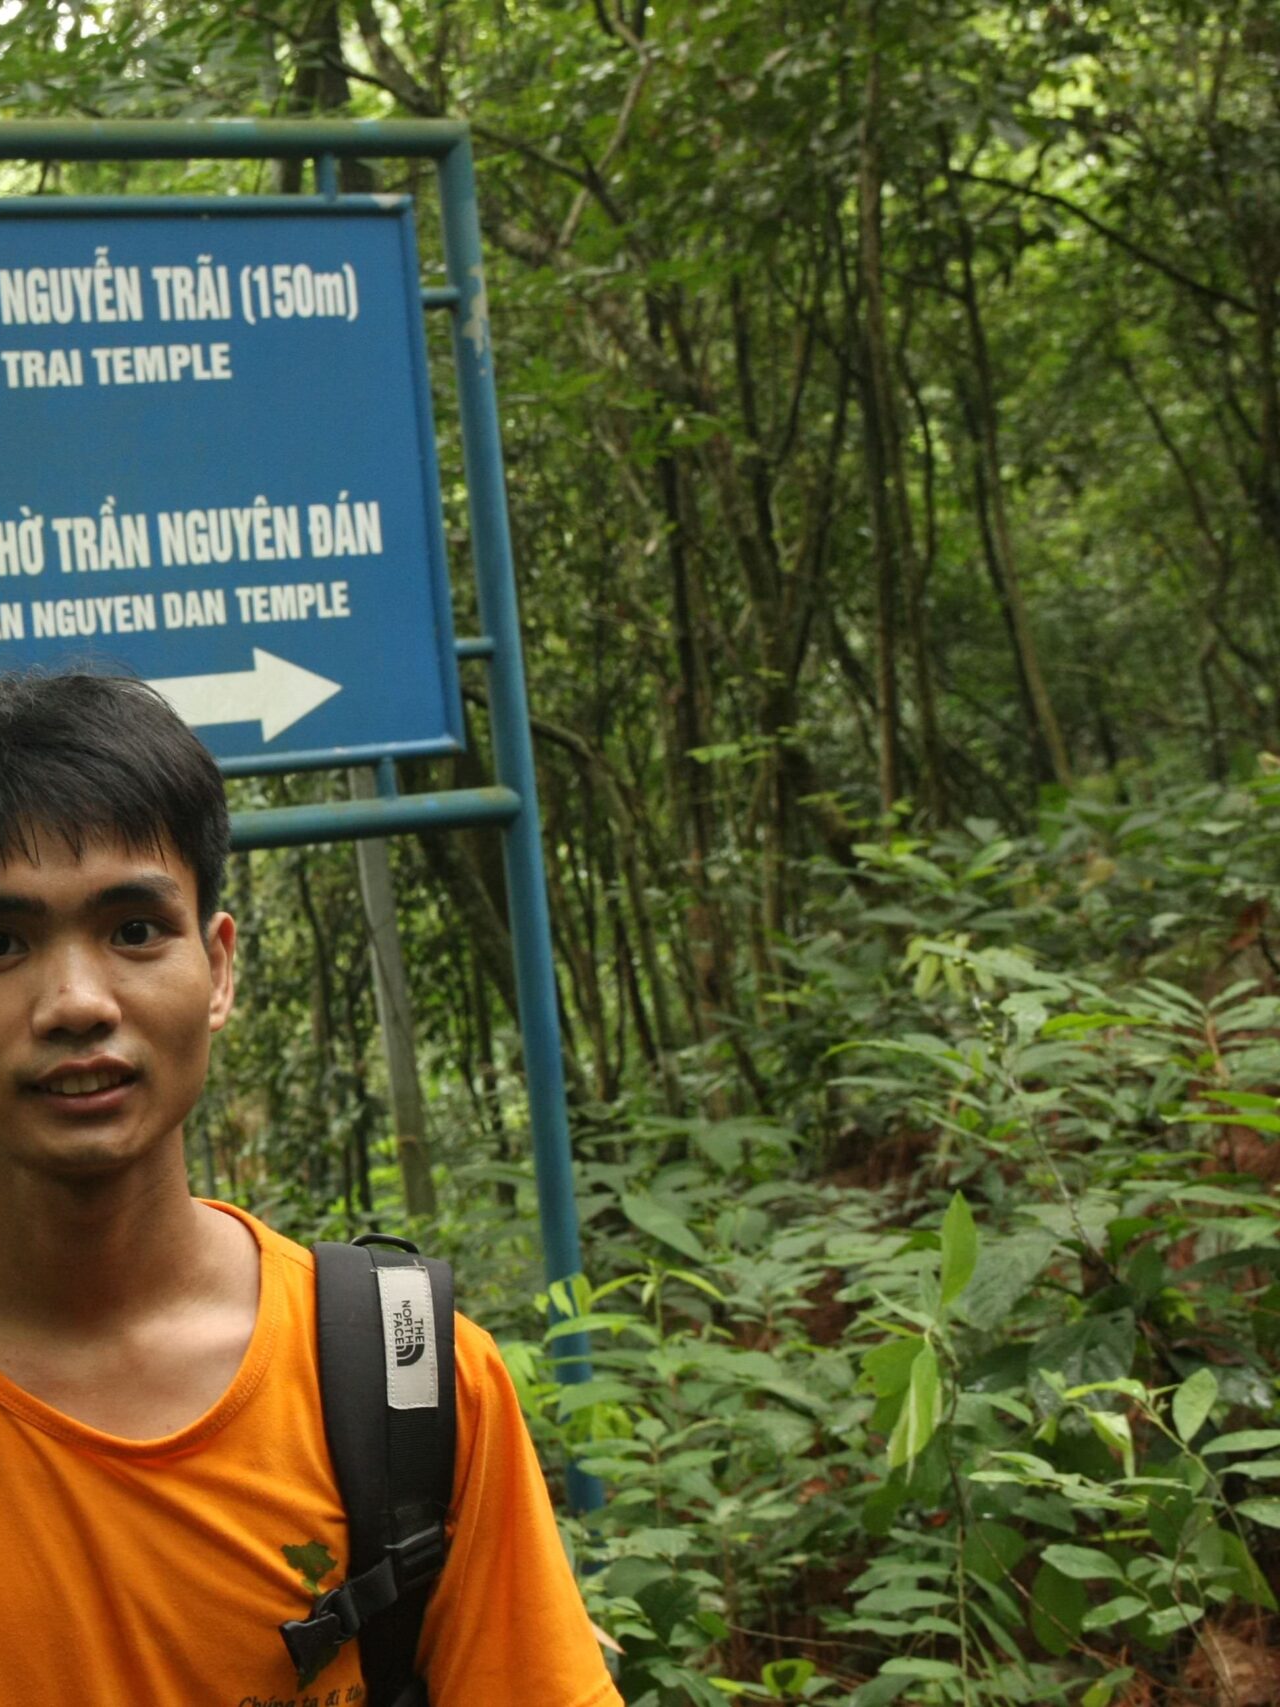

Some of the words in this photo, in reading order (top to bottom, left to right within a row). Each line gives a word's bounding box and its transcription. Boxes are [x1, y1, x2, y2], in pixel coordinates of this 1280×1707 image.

[151, 254, 231, 322] TRÃI
[240, 263, 359, 325] (150m)
[0, 349, 84, 388] TRAI
[91, 343, 232, 385] TEMPLE
[51, 495, 151, 573] TRẦN
[157, 495, 301, 567] NGUYÊN
[308, 490, 382, 558] ĐÁN
[31, 594, 157, 638] NGUYEN
[162, 588, 227, 629] DAN
[235, 581, 351, 623] TEMPLE
[393, 1312, 405, 1345] FACE
[402, 1300, 415, 1343] NORTH
[414, 1318, 425, 1344] THE
